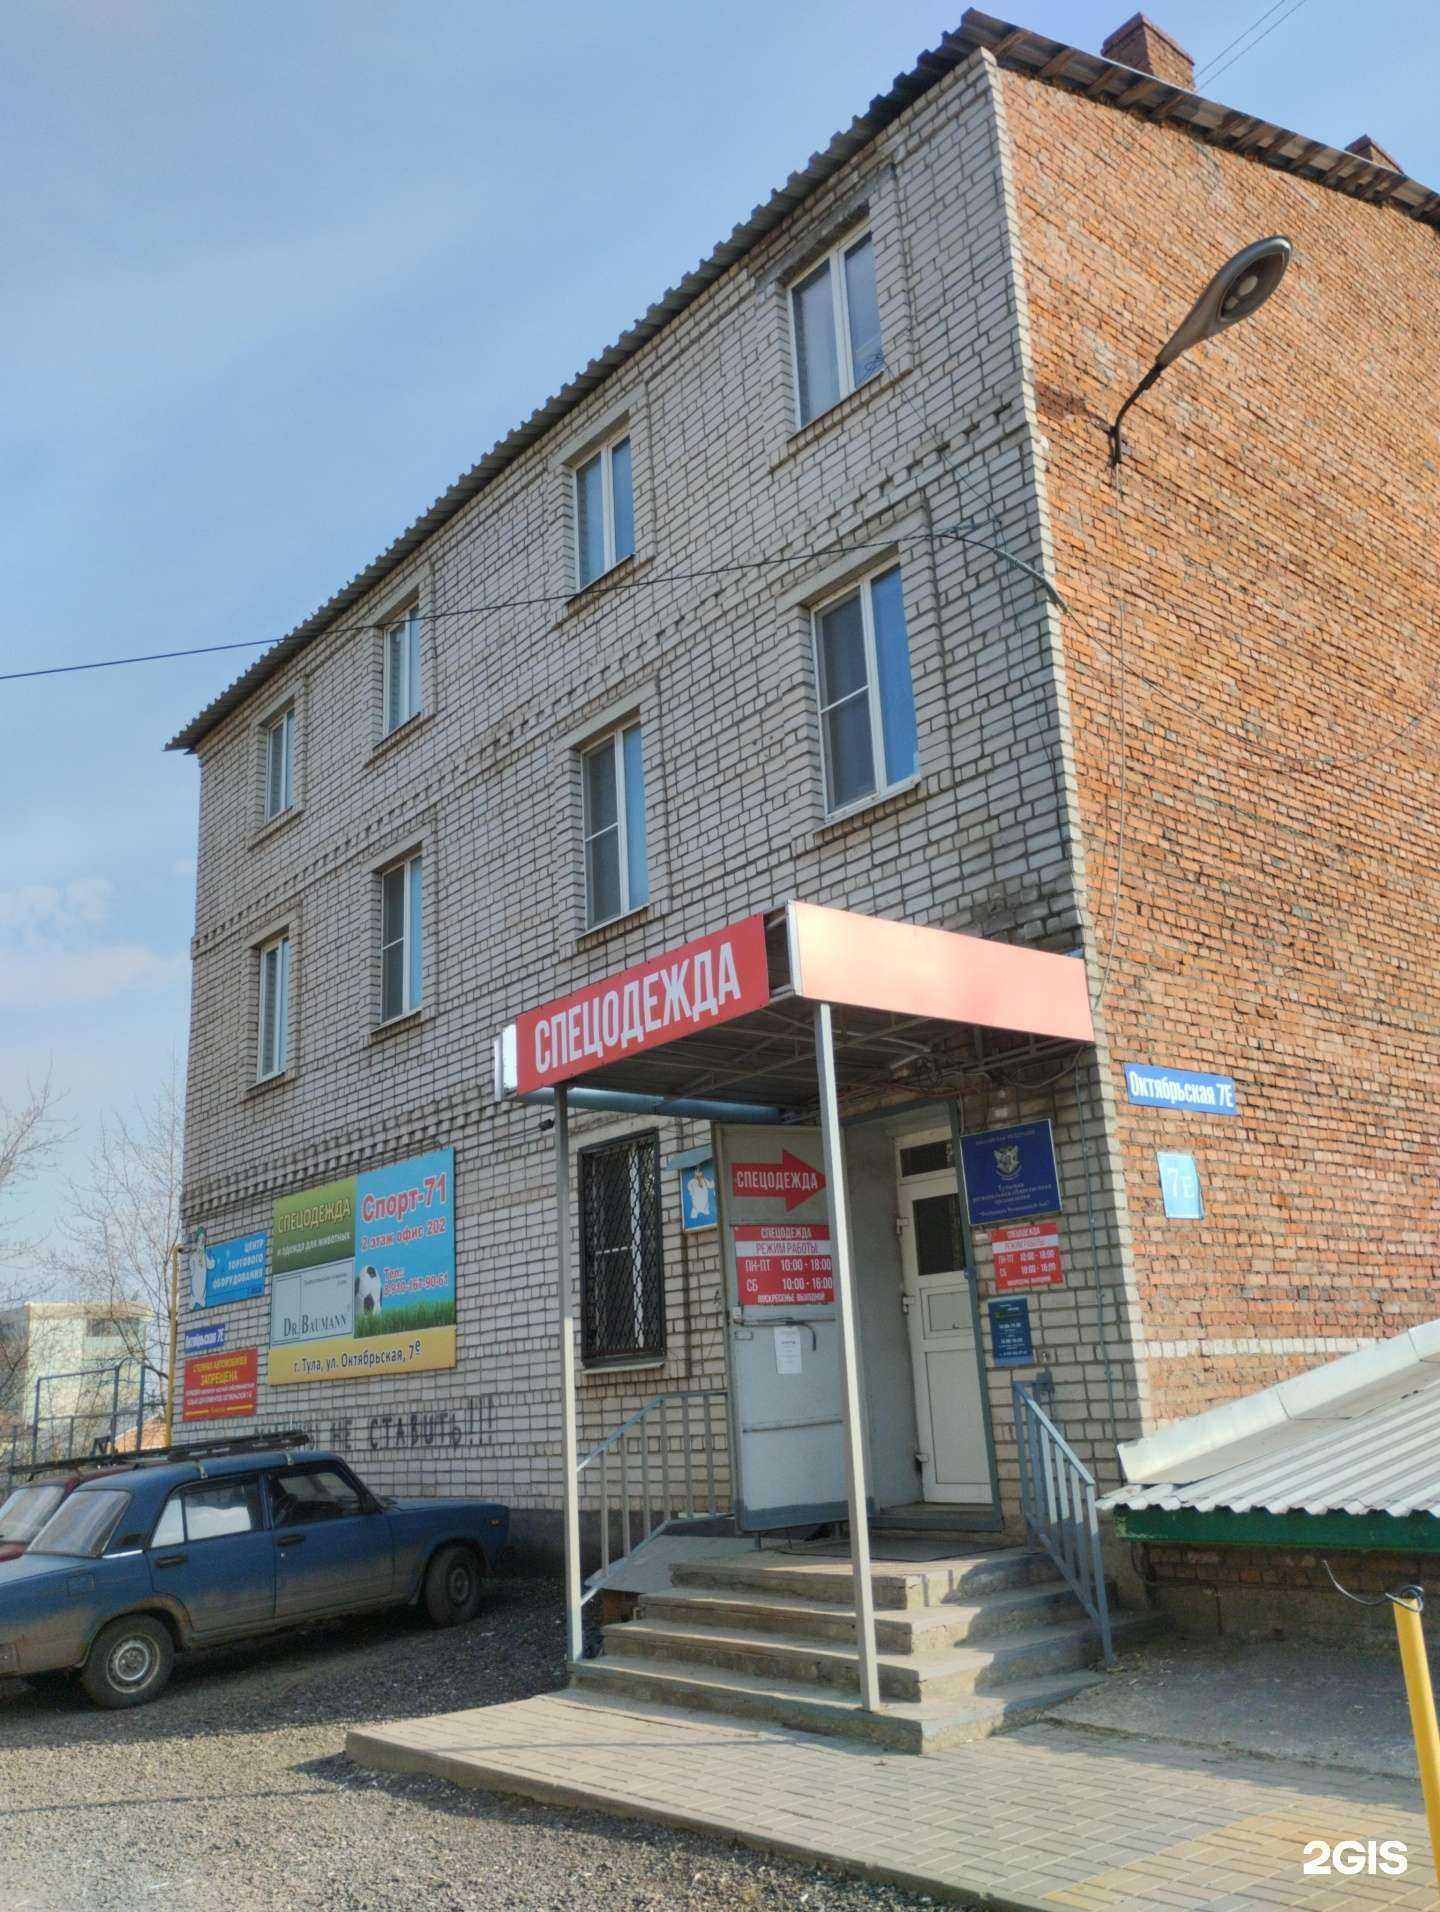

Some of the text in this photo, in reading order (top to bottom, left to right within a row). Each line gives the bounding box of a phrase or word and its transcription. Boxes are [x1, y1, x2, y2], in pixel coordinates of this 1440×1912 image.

[534, 942, 742, 1074] СПЕЦОДЕЖДА
[1129, 1071, 1234, 1108] Октябрьская 7Е
[736, 1170, 818, 1191] СПЕЦОДЕЖДА
[362, 1171, 448, 1223] Спорт-71
[278, 1199, 351, 1234] СПЕЦОДЕЖДА
[371, 1233, 394, 1249] этаж
[396, 1226, 424, 1244] офис
[425, 1216, 447, 1236] 202
[760, 1227, 812, 1240] СПЕЦОДЕЖДА
[755, 1242, 818, 1255] РЕЖИМ РАБОТЫ
[745, 1259, 770, 1272] ПН-ПТ
[781, 1259, 803, 1271] 10:00
[811, 1258, 831, 1271] 18:00
[746, 1278, 758, 1292] СБ
[783, 1278, 805, 1291] 10:00
[294, 1361, 301, 1373] г.
[302, 1357, 323, 1375] Тула,
[326, 1358, 338, 1372] ул.
[341, 1348, 406, 1368] Октябрьская,
[201, 1368, 238, 1386] ЗАПРЕЩЕНА
[330, 1418, 354, 1449] НЕ
